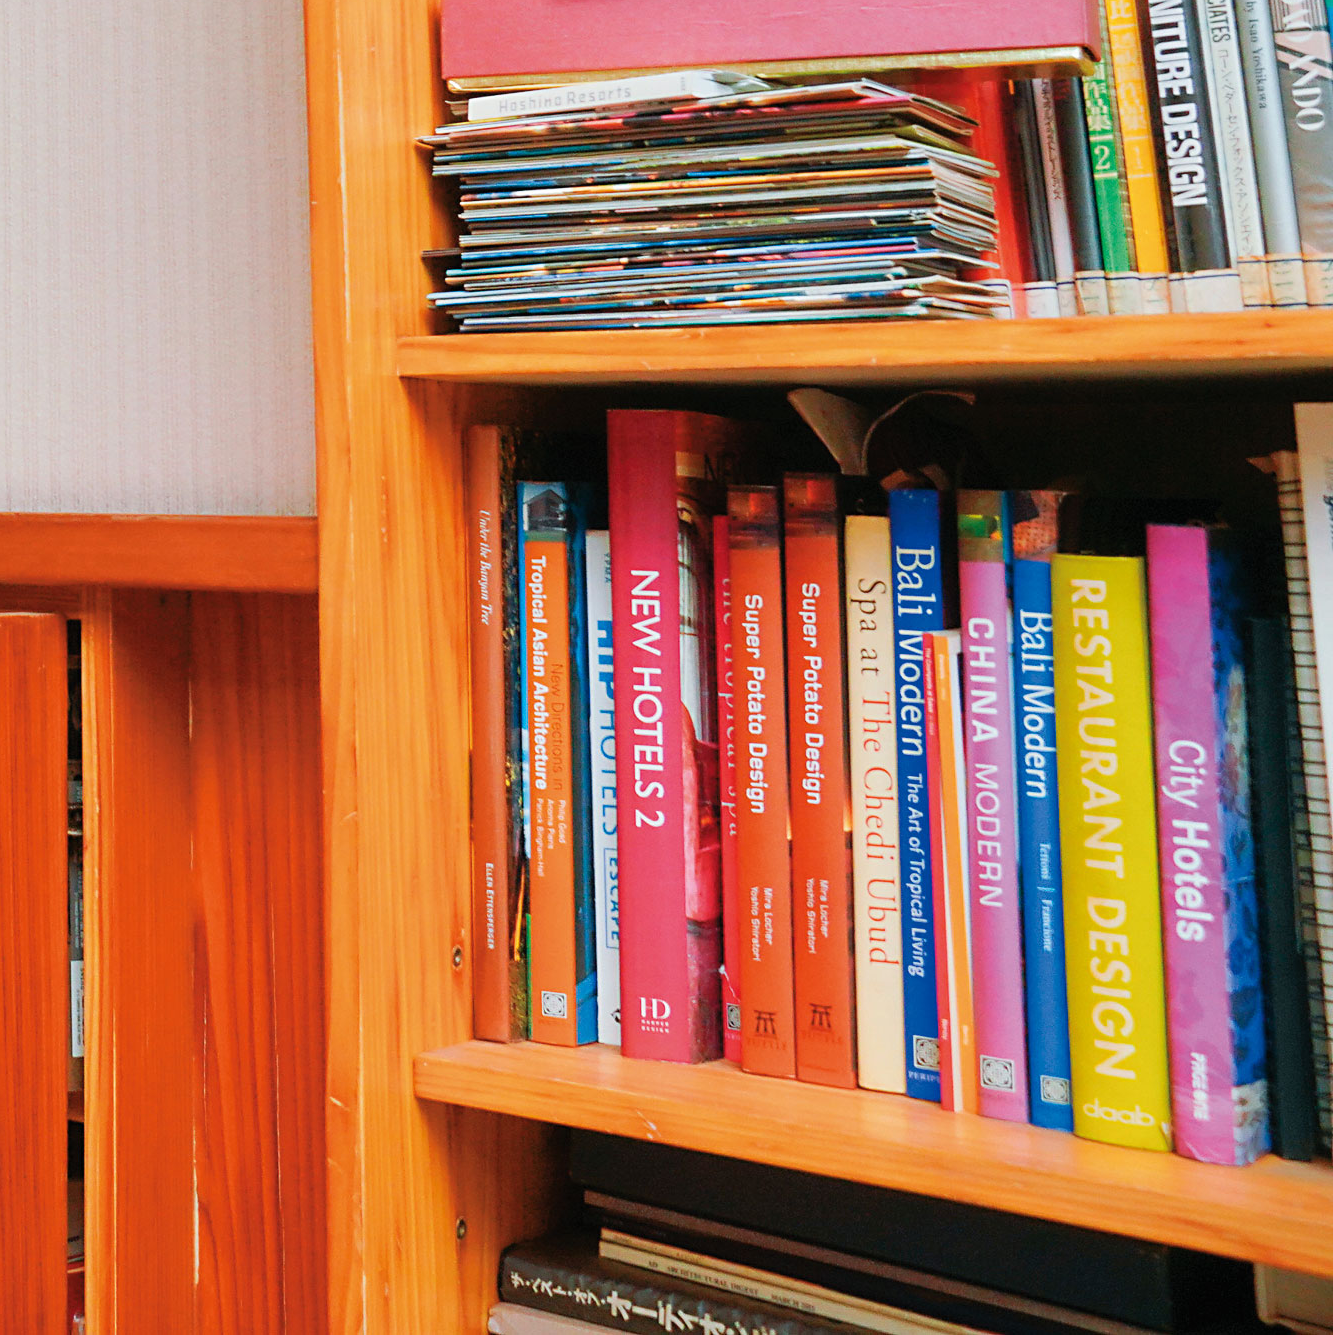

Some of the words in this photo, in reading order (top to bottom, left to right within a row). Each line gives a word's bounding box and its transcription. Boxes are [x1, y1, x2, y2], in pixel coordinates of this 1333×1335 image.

[1245, 1, 1256, 16] by
[1248, 18, 1258, 41] Isao
[498, 95, 563, 115] Hoshino
[566, 85, 632, 105] Resorts
[1251, 47, 1268, 110] Yoshikawa
[1094, 145, 1111, 170] 2
[1160, 102, 1208, 207] DESIGN
[479, 509, 491, 540] Under
[480, 542, 491, 558] the
[480, 562, 492, 601] Banyan
[531, 556, 547, 623] Tropical
[851, 578, 886, 633] Spa
[896, 546, 937, 617] Bali
[481, 602, 493, 625] Tree
[630, 570, 662, 656] NEW
[742, 595, 763, 659] Super
[802, 583, 821, 649] Super
[1019, 609, 1053, 673] Bali
[532, 628, 549, 677] Asian
[550, 663, 563, 697] New
[860, 646, 879, 677] at
[968, 617, 999, 742] CHINA
[746, 666, 766, 735] Potato
[803, 655, 824, 725] Potato
[897, 629, 926, 757] Modern
[533, 680, 550, 790] Architecture
[551, 702, 565, 773] Directions
[632, 667, 665, 799] HOTELS
[862, 691, 892, 753] The
[1023, 684, 1056, 798] Modern
[1070, 577, 1124, 879] RESTAURANT
[553, 777, 563, 791] in
[748, 742, 768, 814] Design
[804, 732, 825, 805] Design
[907, 774, 923, 803] The
[1163, 738, 1207, 808] City
[558, 799, 566, 820] Philip
[635, 810, 666, 828] 2
[863, 767, 896, 861] Chedi
[907, 807, 923, 832] Art
[974, 763, 1003, 908] MODERN
[908, 836, 923, 853] of
[1039, 842, 1051, 879] Tettoni
[806, 878, 816, 908] Yoshio
[818, 879, 829, 902] Mira
[910, 854, 926, 924] Tropical
[1171, 817, 1213, 944] Hotels
[807, 910, 817, 954] Shiratori
[820, 904, 830, 938] Locher
[867, 878, 900, 966] Ubud
[908, 928, 928, 978] Living
[639, 997, 671, 1019] HD
[1085, 894, 1137, 1081] DESIGN
[1083, 1099, 1155, 1127] daab
